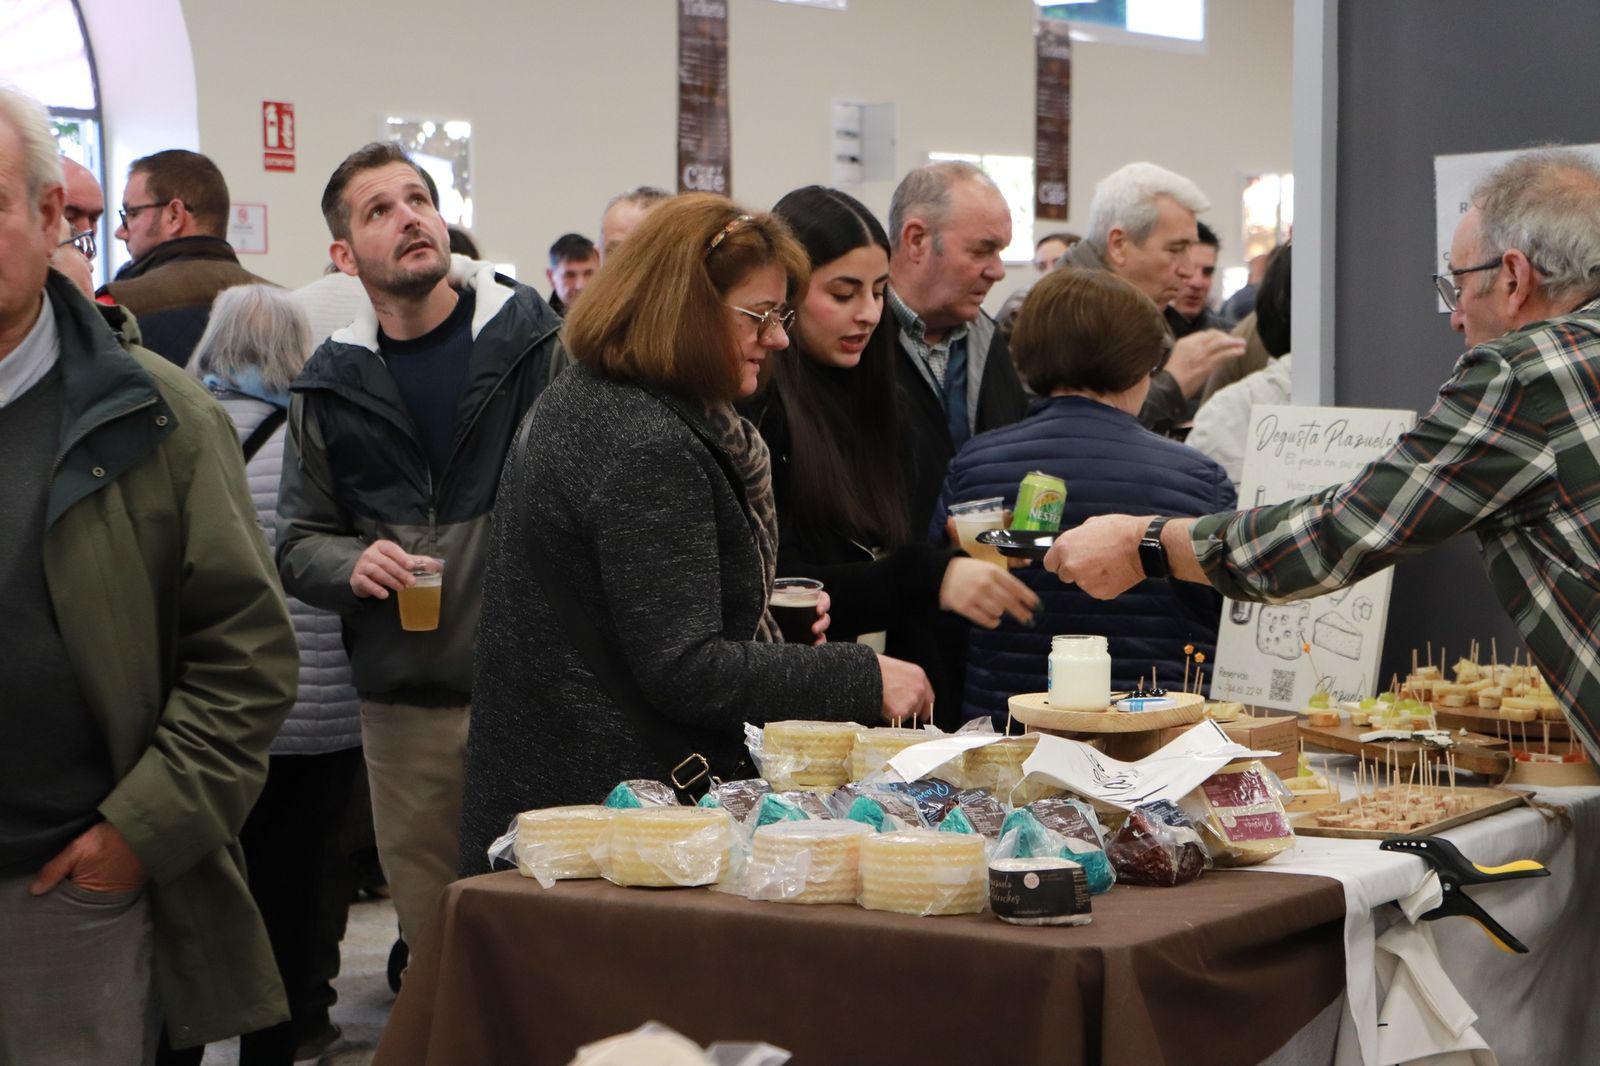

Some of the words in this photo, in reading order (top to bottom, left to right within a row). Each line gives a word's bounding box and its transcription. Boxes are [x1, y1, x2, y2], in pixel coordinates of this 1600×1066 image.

[684, 162, 725, 192] Café
[1255, 413, 1319, 458] Degusta
[1324, 417, 1393, 454] Plazuelo
[1218, 666, 1249, 681] Reservas
